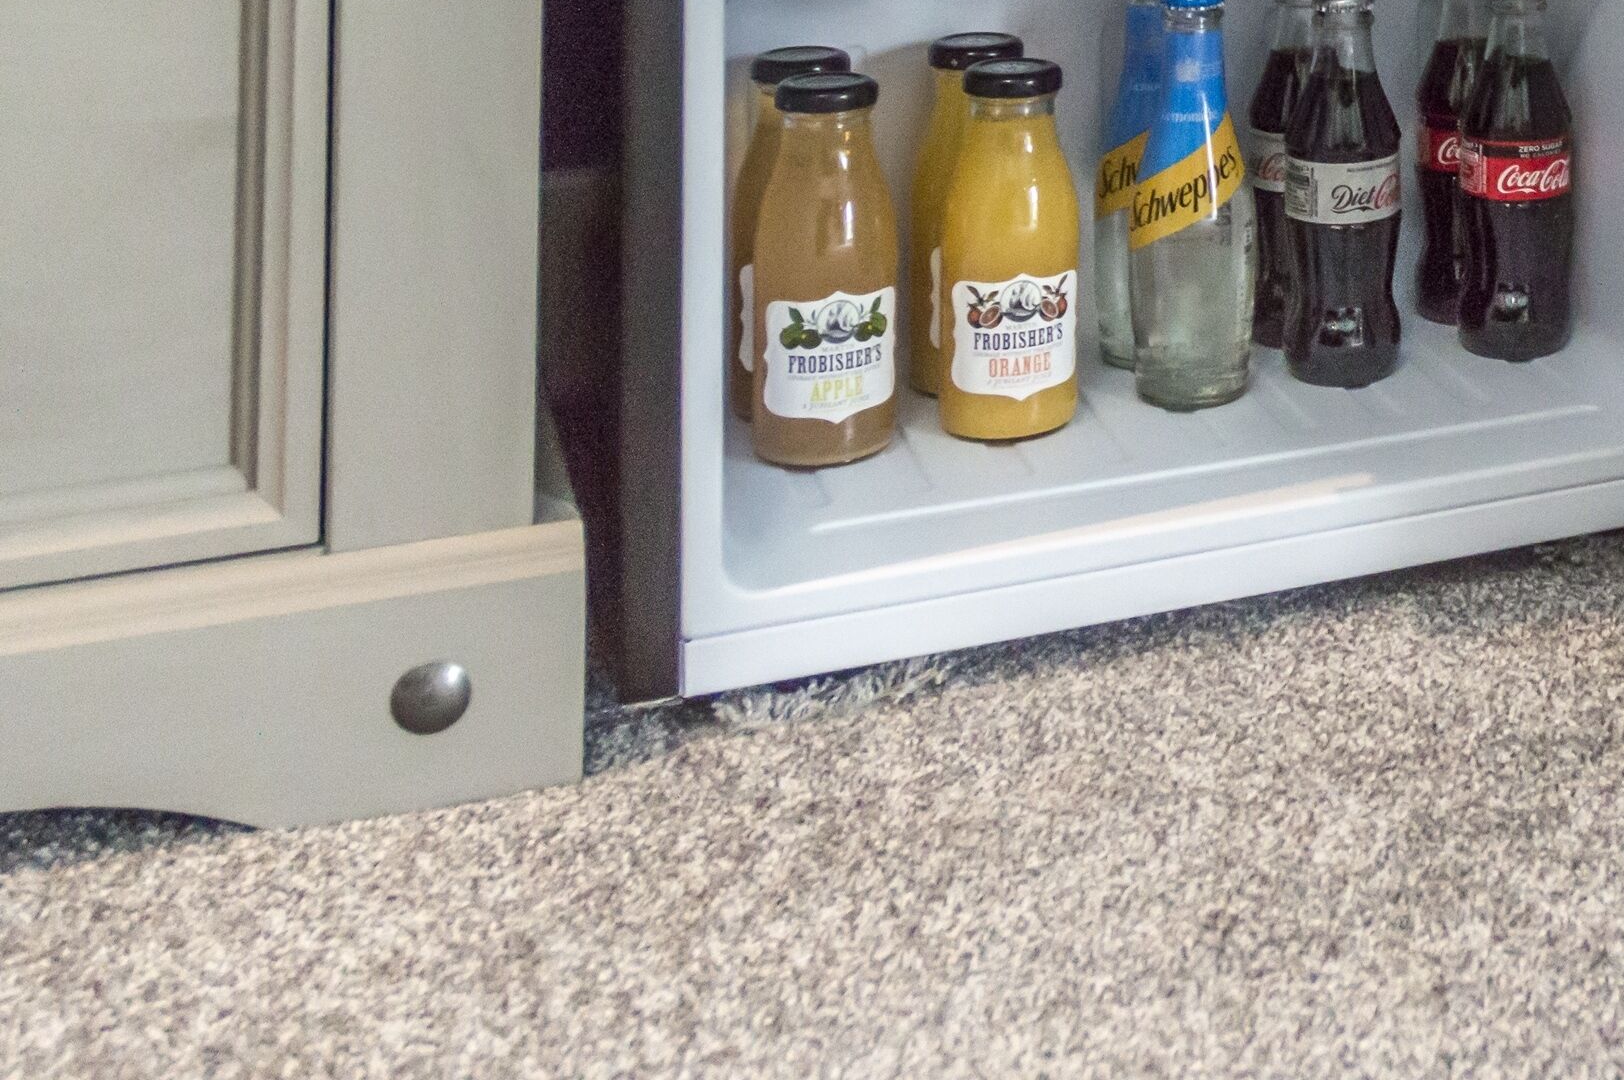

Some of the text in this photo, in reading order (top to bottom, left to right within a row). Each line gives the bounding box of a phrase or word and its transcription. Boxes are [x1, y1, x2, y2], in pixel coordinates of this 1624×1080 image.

[1518, 145, 1540, 153] ZERO
[1330, 183, 1376, 212] Diet
[973, 322, 1063, 351] FROBISHER'S
[787, 343, 883, 375] FROBISHER'S
[988, 351, 1052, 378] ORANGE
[809, 375, 865, 404] APPLE
